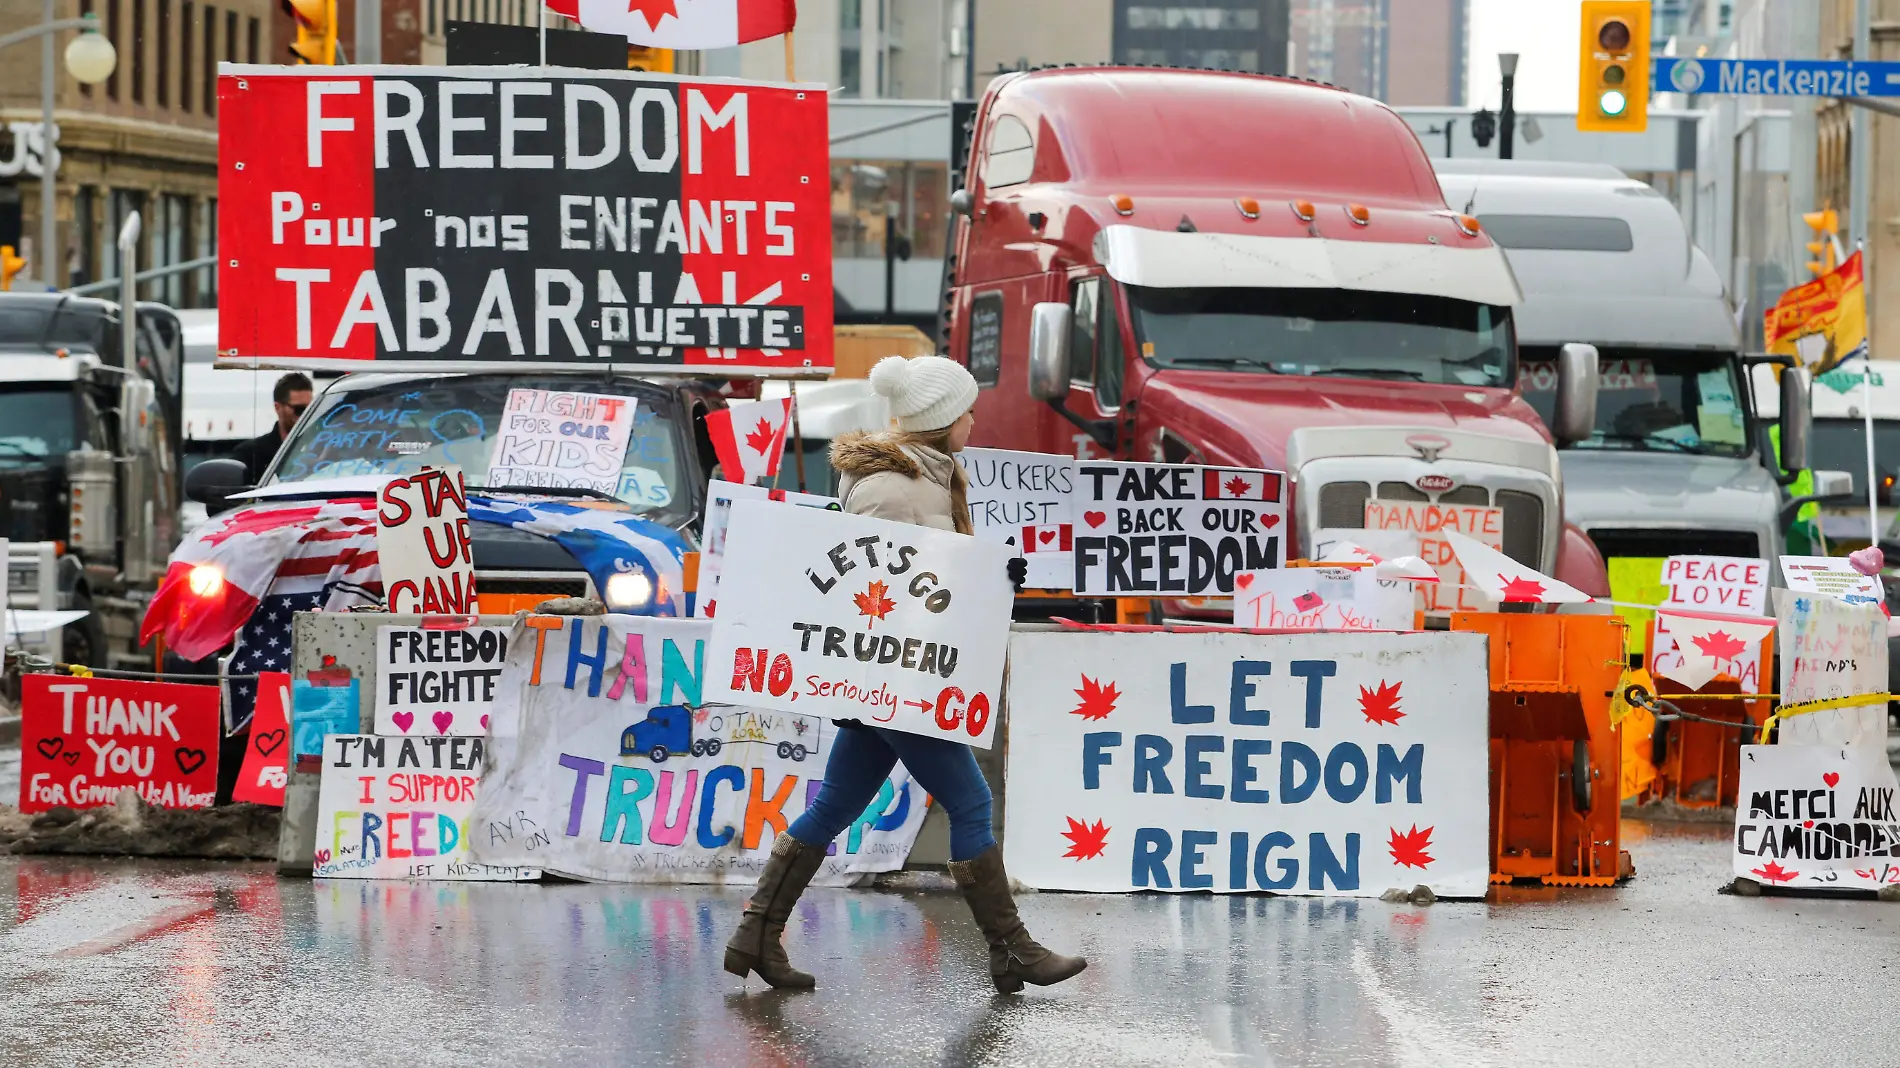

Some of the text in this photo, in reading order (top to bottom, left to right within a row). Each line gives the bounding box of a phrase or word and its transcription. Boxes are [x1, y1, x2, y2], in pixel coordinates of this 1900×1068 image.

[1719, 60, 1870, 96] Mackenzie
[307, 81, 750, 176] FREEDOM
[271, 191, 795, 256] Pour nos ENFANTS
[322, 404, 420, 428] COME
[509, 391, 625, 421] FIGHT
[310, 430, 399, 452] PARTY
[511, 415, 609, 440] FOR OUR
[500, 436, 622, 477] KIDS
[1080, 467, 1195, 501] TAKE
[968, 499, 1058, 526] TRUST
[1117, 508, 1259, 534] BACK OUR
[1365, 505, 1501, 533] MANDATE
[423, 518, 471, 569] UP
[805, 535, 952, 613] LET'S GO
[1075, 534, 1278, 593] FREEDOM
[1668, 560, 1760, 584] PEACE
[1248, 591, 1330, 628] Thank
[1671, 584, 1752, 607] LOVE
[390, 630, 507, 664] FREEDO
[525, 616, 705, 709] THAN
[793, 622, 958, 678] TRUDEAU
[730, 647, 990, 737] NO, Seriously GO
[1170, 660, 1337, 729] LET
[48, 684, 181, 742] THANK
[710, 711, 786, 733] OTTAWA
[86, 738, 155, 777] YOU
[334, 737, 386, 769] I'M
[398, 738, 420, 769] A
[1082, 731, 1424, 804] FREEDOM
[358, 773, 481, 804] I SUPPOR
[1853, 786, 1896, 822] AUX
[334, 811, 470, 860] FREED
[489, 810, 536, 847] AYR
[525, 829, 551, 851] ON
[314, 848, 331, 869] NO
[409, 864, 434, 877] LET
[447, 861, 480, 876] KIDS
[653, 853, 725, 869] TRUCKERS
[730, 856, 754, 870] FOR
[1131, 827, 1360, 891] REIGN
